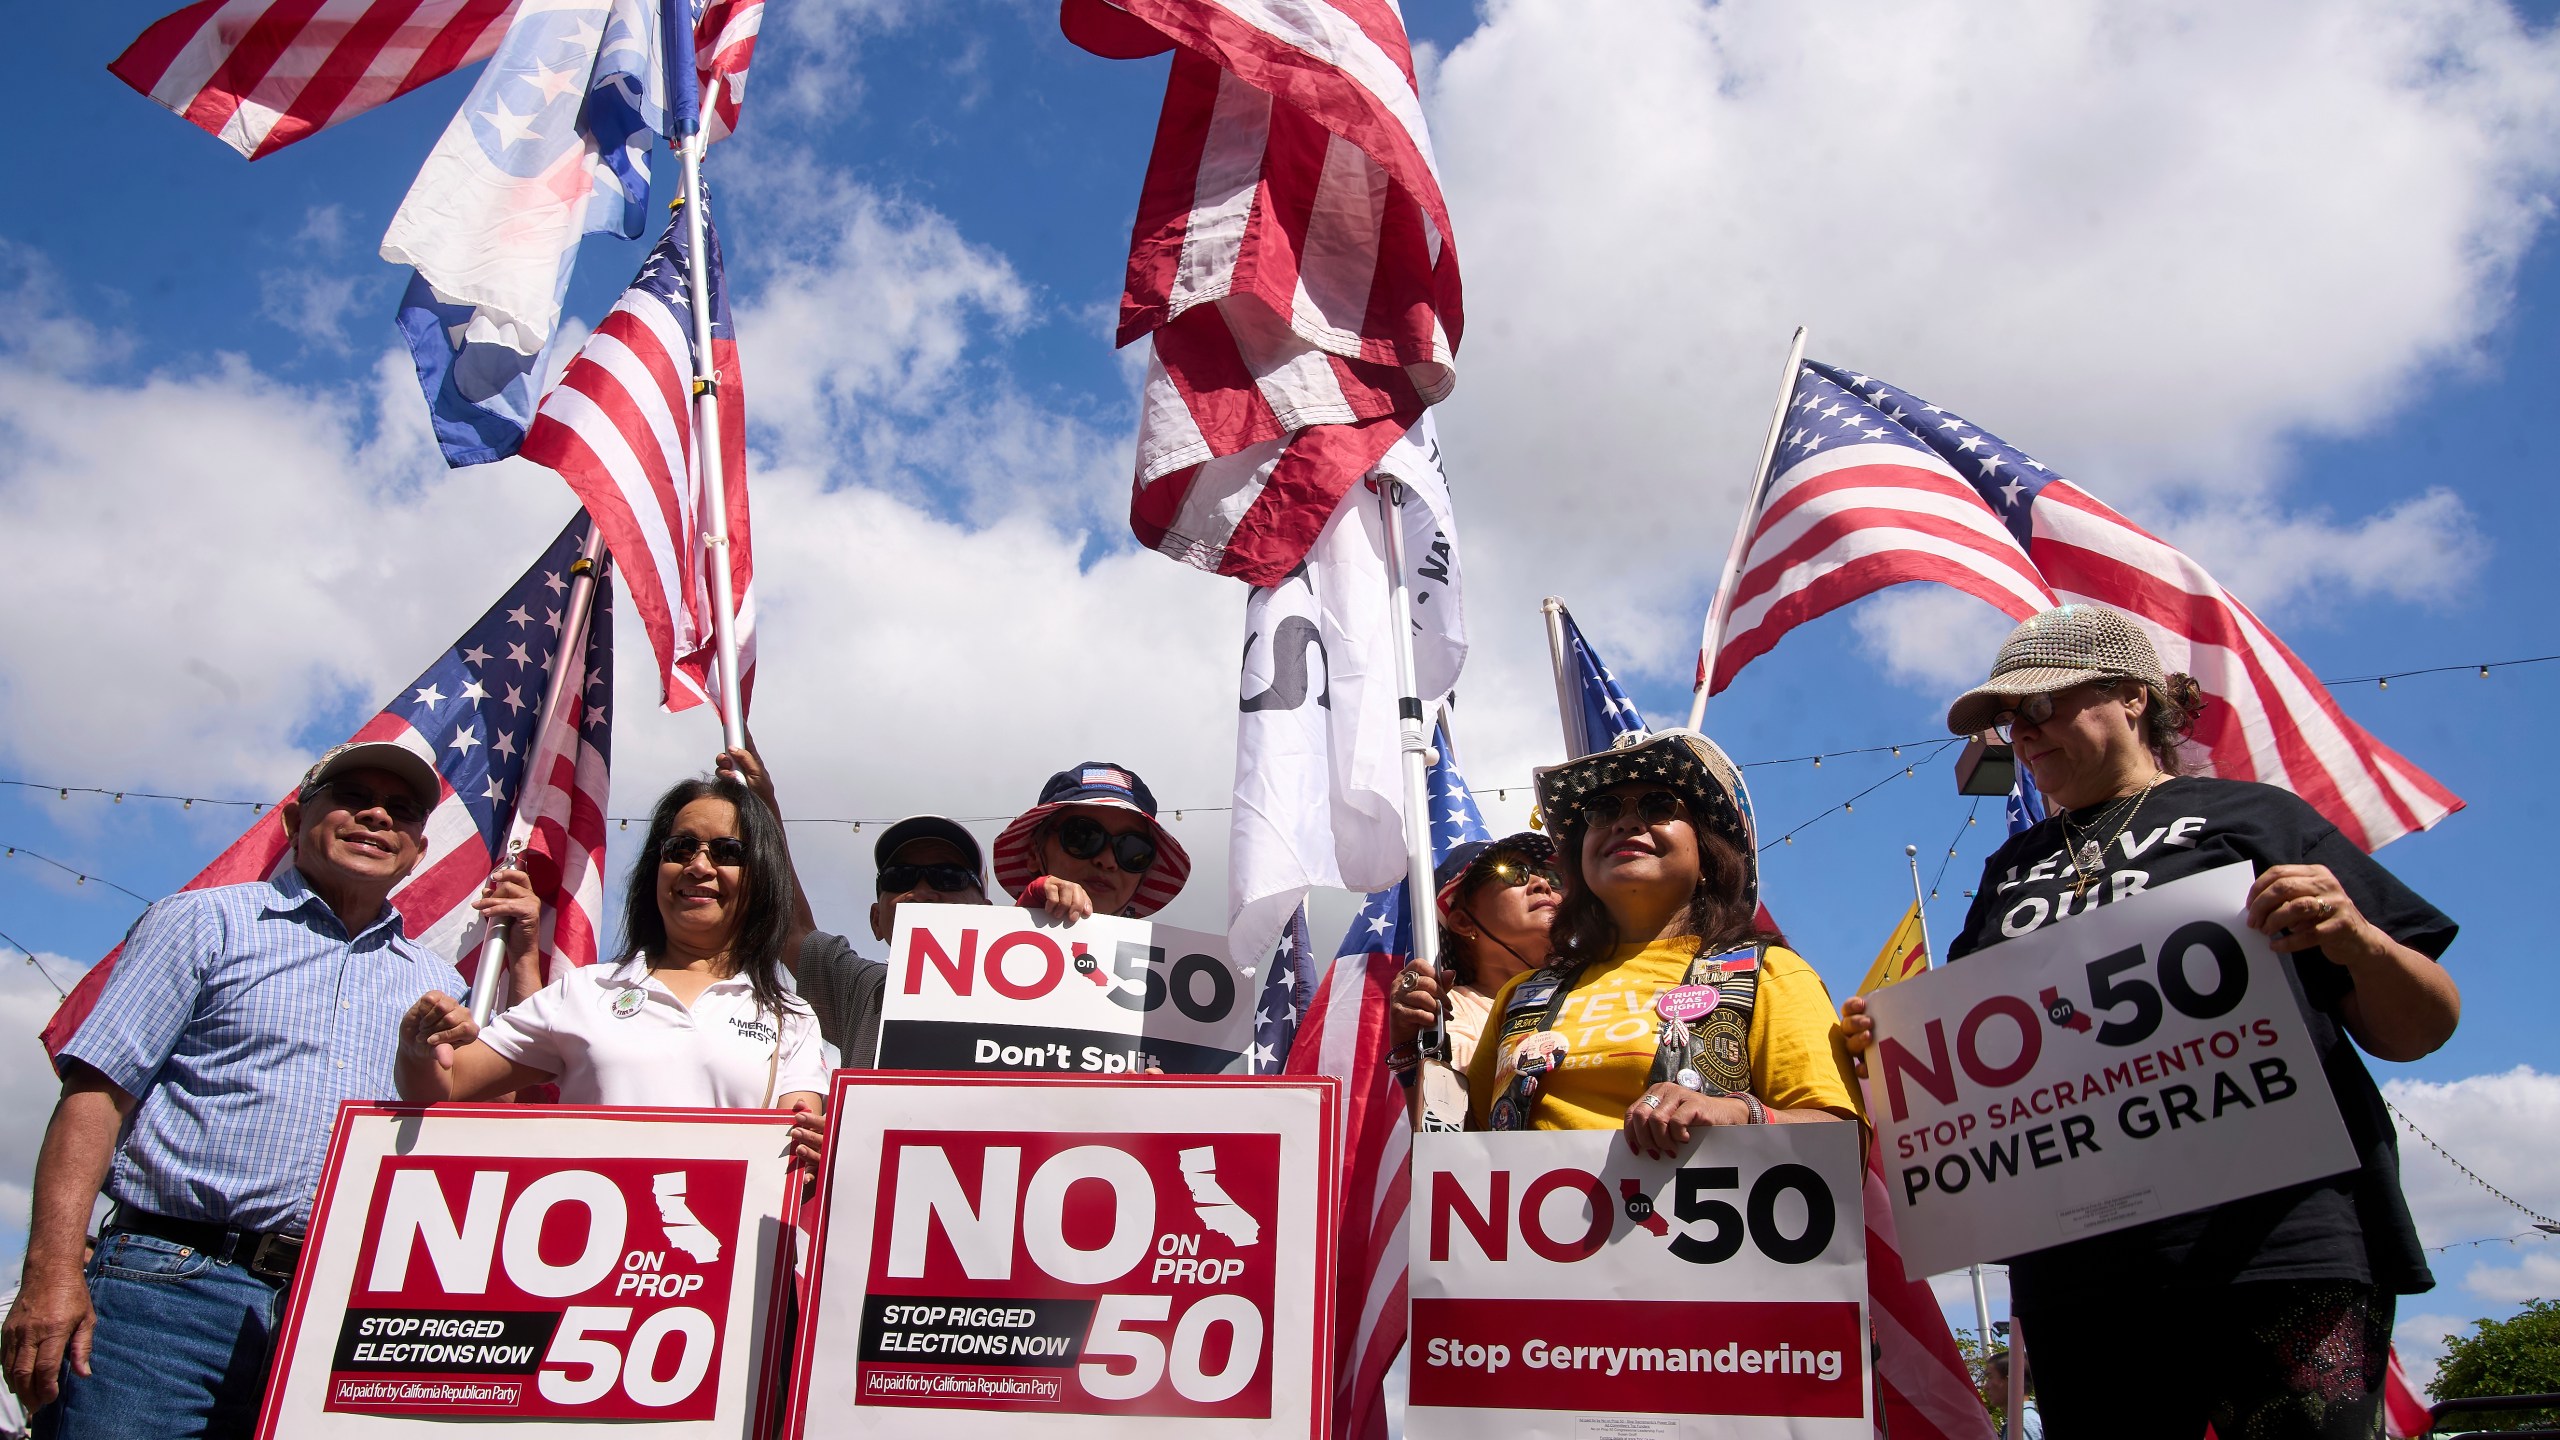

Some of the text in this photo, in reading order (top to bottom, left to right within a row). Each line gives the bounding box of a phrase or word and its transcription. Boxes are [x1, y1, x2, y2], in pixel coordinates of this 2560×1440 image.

[2001, 869, 2150, 938] OUR
[903, 927, 1236, 1024] NO on 50
[1552, 987, 1667, 1027] TEV
[1665, 1002, 1708, 1012] RIGHT!
[1667, 990, 1710, 1000] TRUMP
[1672, 996, 1703, 1005] WAS
[729, 1017, 777, 1042] AMERICA
[1878, 920, 2249, 1124] NO on 50
[738, 1029, 771, 1044] FIRST
[975, 1039, 1072, 1069] Don't
[1897, 1018, 2279, 1160] STOP SACRAMENTO'S
[1902, 1056, 2299, 1207] POWER GRAB
[887, 1145, 1156, 1285] NO
[1429, 1163, 1836, 1264] NO on 50
[367, 1169, 628, 1298] NO
[1157, 1233, 1201, 1256] ON
[623, 1250, 666, 1271] ON
[1151, 1258, 1245, 1285] PROP
[615, 1273, 705, 1298] PROP
[359, 1317, 505, 1338] STOP RIGGED
[882, 1305, 1036, 1328] STOP RIGGED
[352, 1343, 534, 1364] ELECTIONS NOW
[538, 1306, 716, 1407] 50
[879, 1332, 1070, 1357] ELECTIONS NOW
[1078, 1294, 1264, 1402] 50
[1426, 1337, 1843, 1381] Stop Gerrymandering
[338, 1382, 518, 1403] Ad paid for by California Republican Party
[868, 1374, 1058, 1399] Ad paid for by California Republican Party
